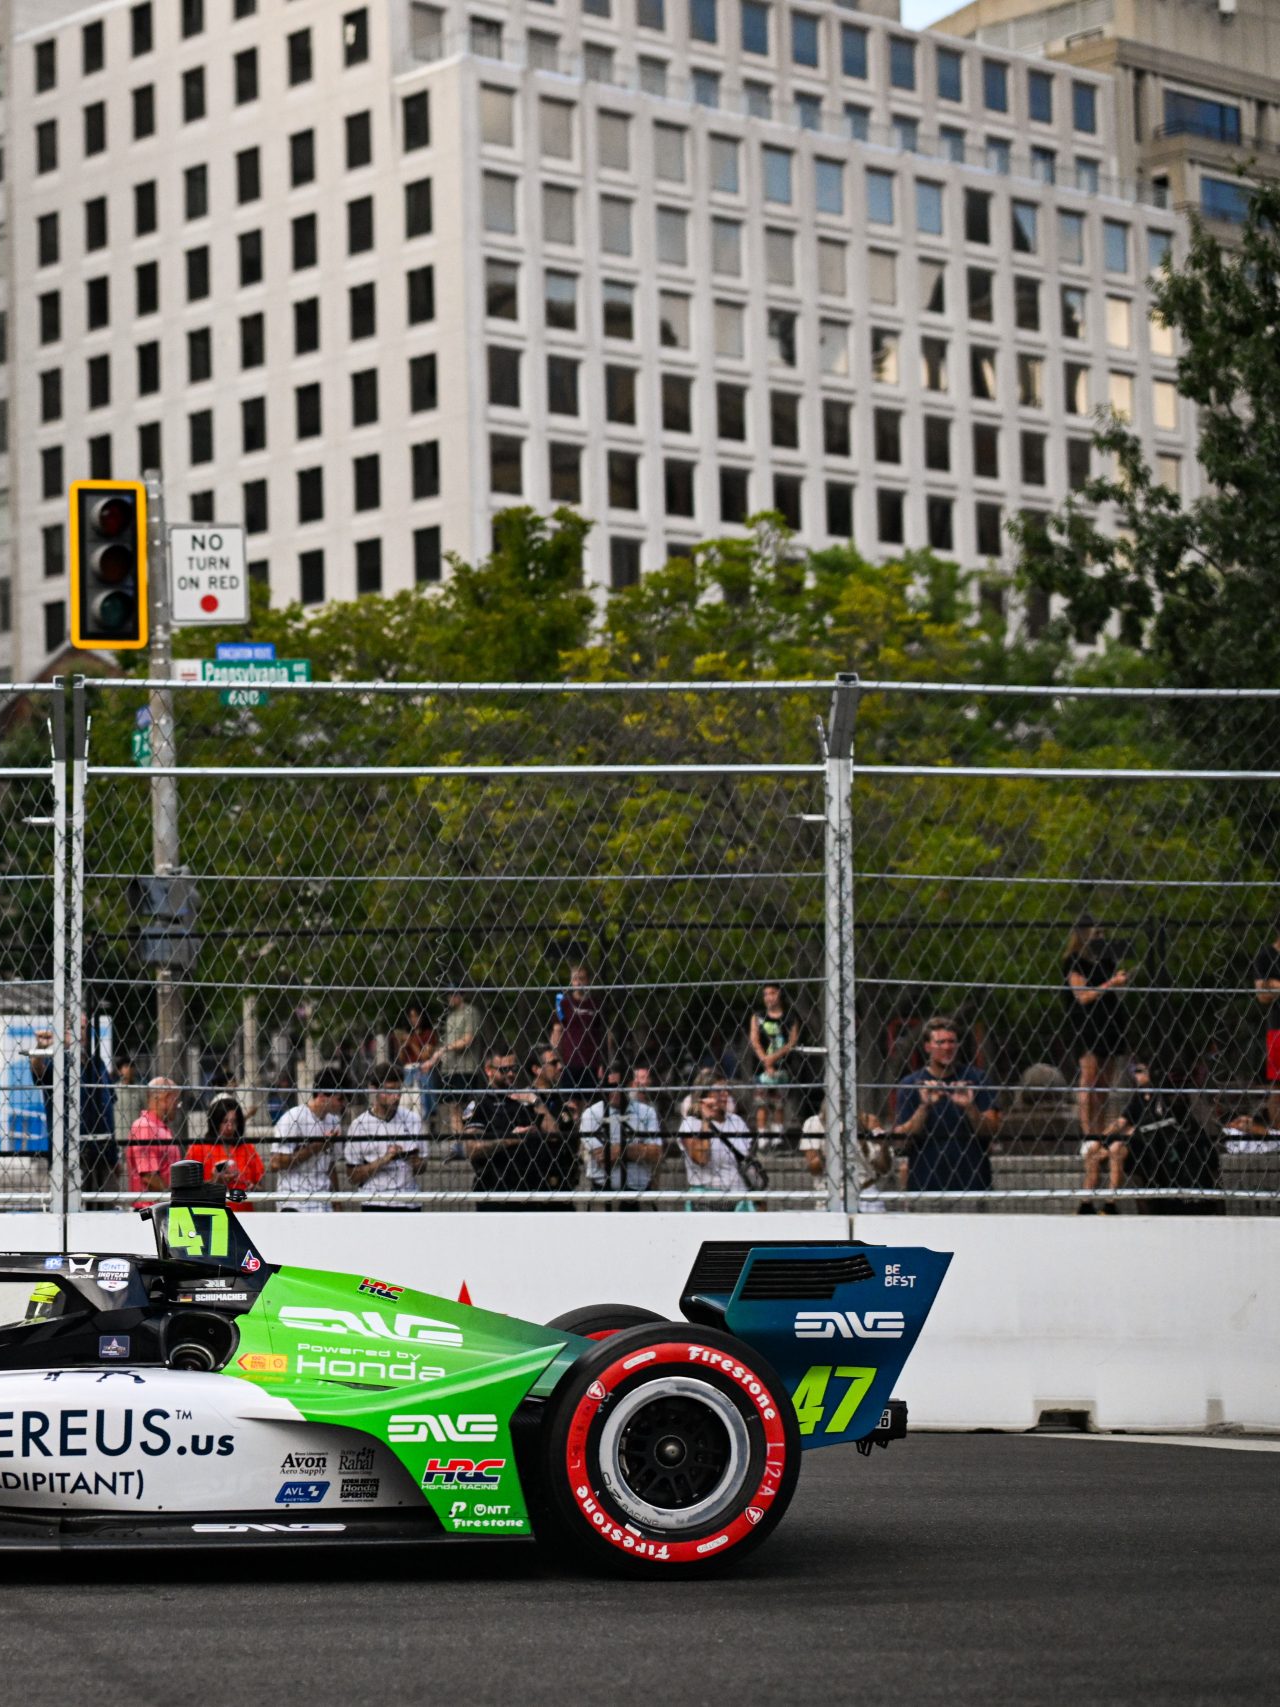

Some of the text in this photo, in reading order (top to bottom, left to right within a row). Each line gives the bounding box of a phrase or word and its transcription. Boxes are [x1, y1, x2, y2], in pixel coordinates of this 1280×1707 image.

[192, 534, 223, 551] NO
[188, 556, 230, 571] TURN
[177, 575, 240, 591] ON RED
[205, 662, 289, 682] Pennsylvania
[168, 1207, 229, 1257] 47
[884, 1264, 901, 1275] BE
[884, 1275, 916, 1288] BEST
[195, 1293, 248, 1302] SCHUMACHER
[297, 1343, 421, 1361] Powered by
[296, 1354, 446, 1381] Honda
[687, 1345, 776, 1421] Firestone
[791, 1365, 877, 1435] 47
[281, 1453, 327, 1468] Avon
[338, 1454, 374, 1470] Rahal
[299, 1467, 327, 1476] Supply
[421, 1458, 507, 1485] HRC
[284, 1487, 305, 1495] AVL
[487, 1505, 511, 1514] NTT
[453, 1518, 524, 1529] Firestone
[576, 1485, 671, 1560] Firestone
